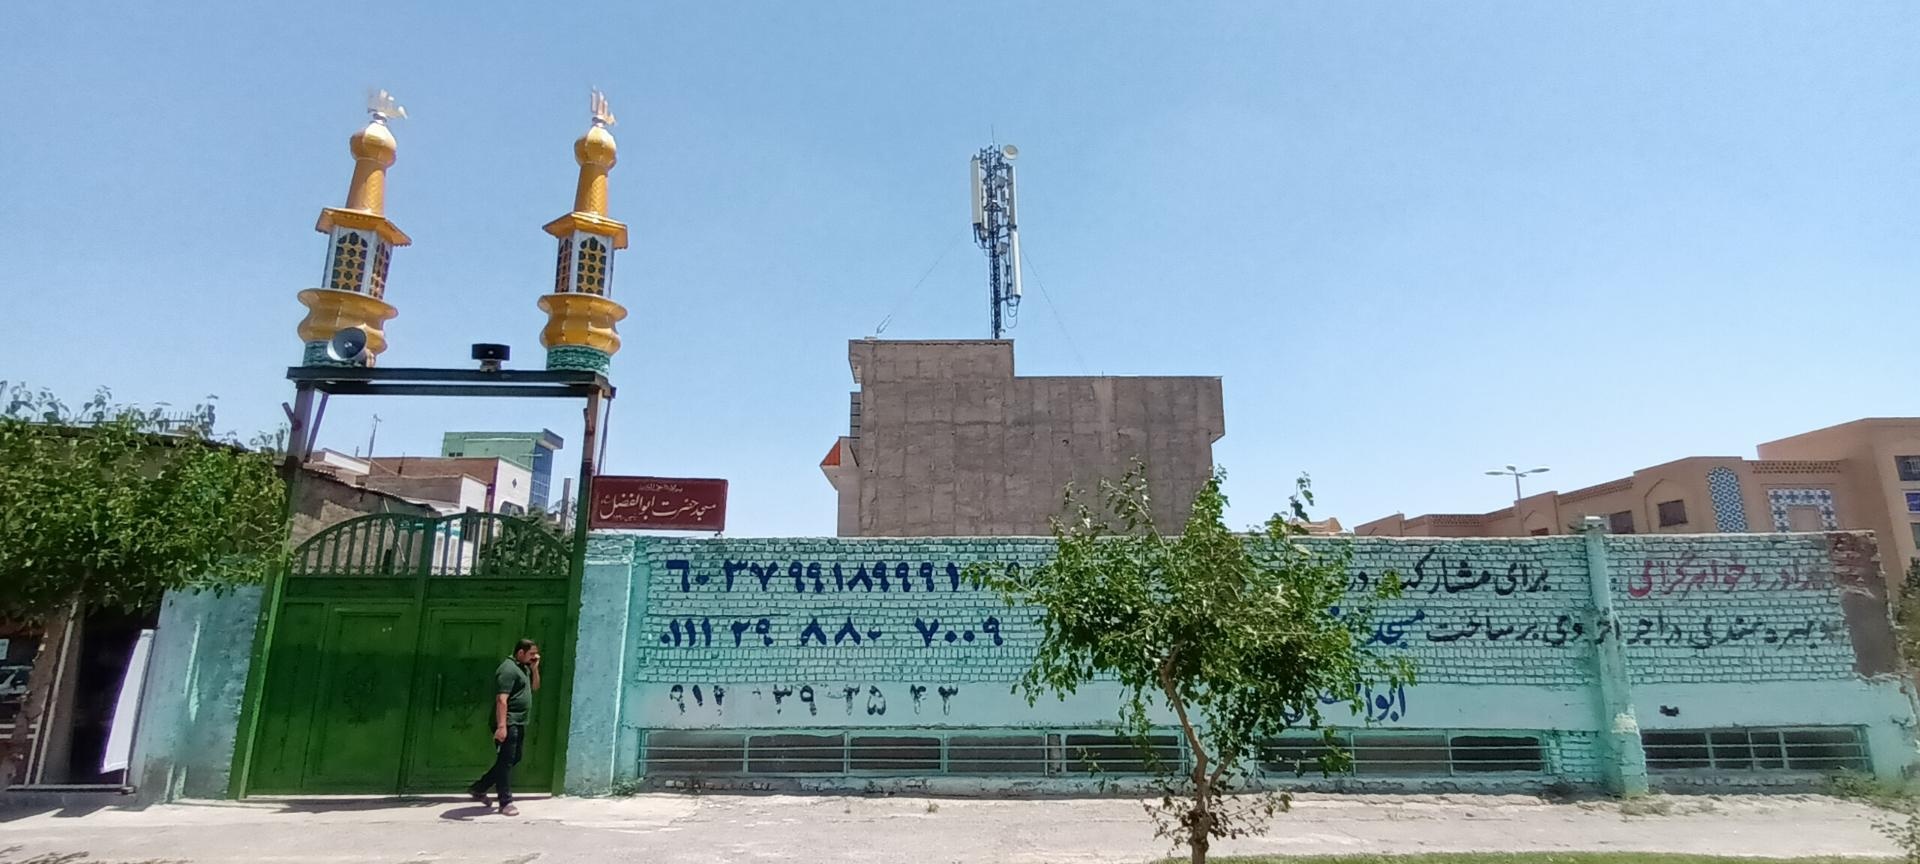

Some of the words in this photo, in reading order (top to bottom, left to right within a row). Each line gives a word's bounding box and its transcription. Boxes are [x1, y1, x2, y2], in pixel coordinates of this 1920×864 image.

[599, 493, 656, 520] ابوالفضل
[651, 498, 699, 520] حضرت
[688, 502, 717, 521] مسجد
[1373, 547, 1492, 596] مشارک
[1494, 561, 1550, 596] برای
[1366, 609, 1425, 649] مسجد
